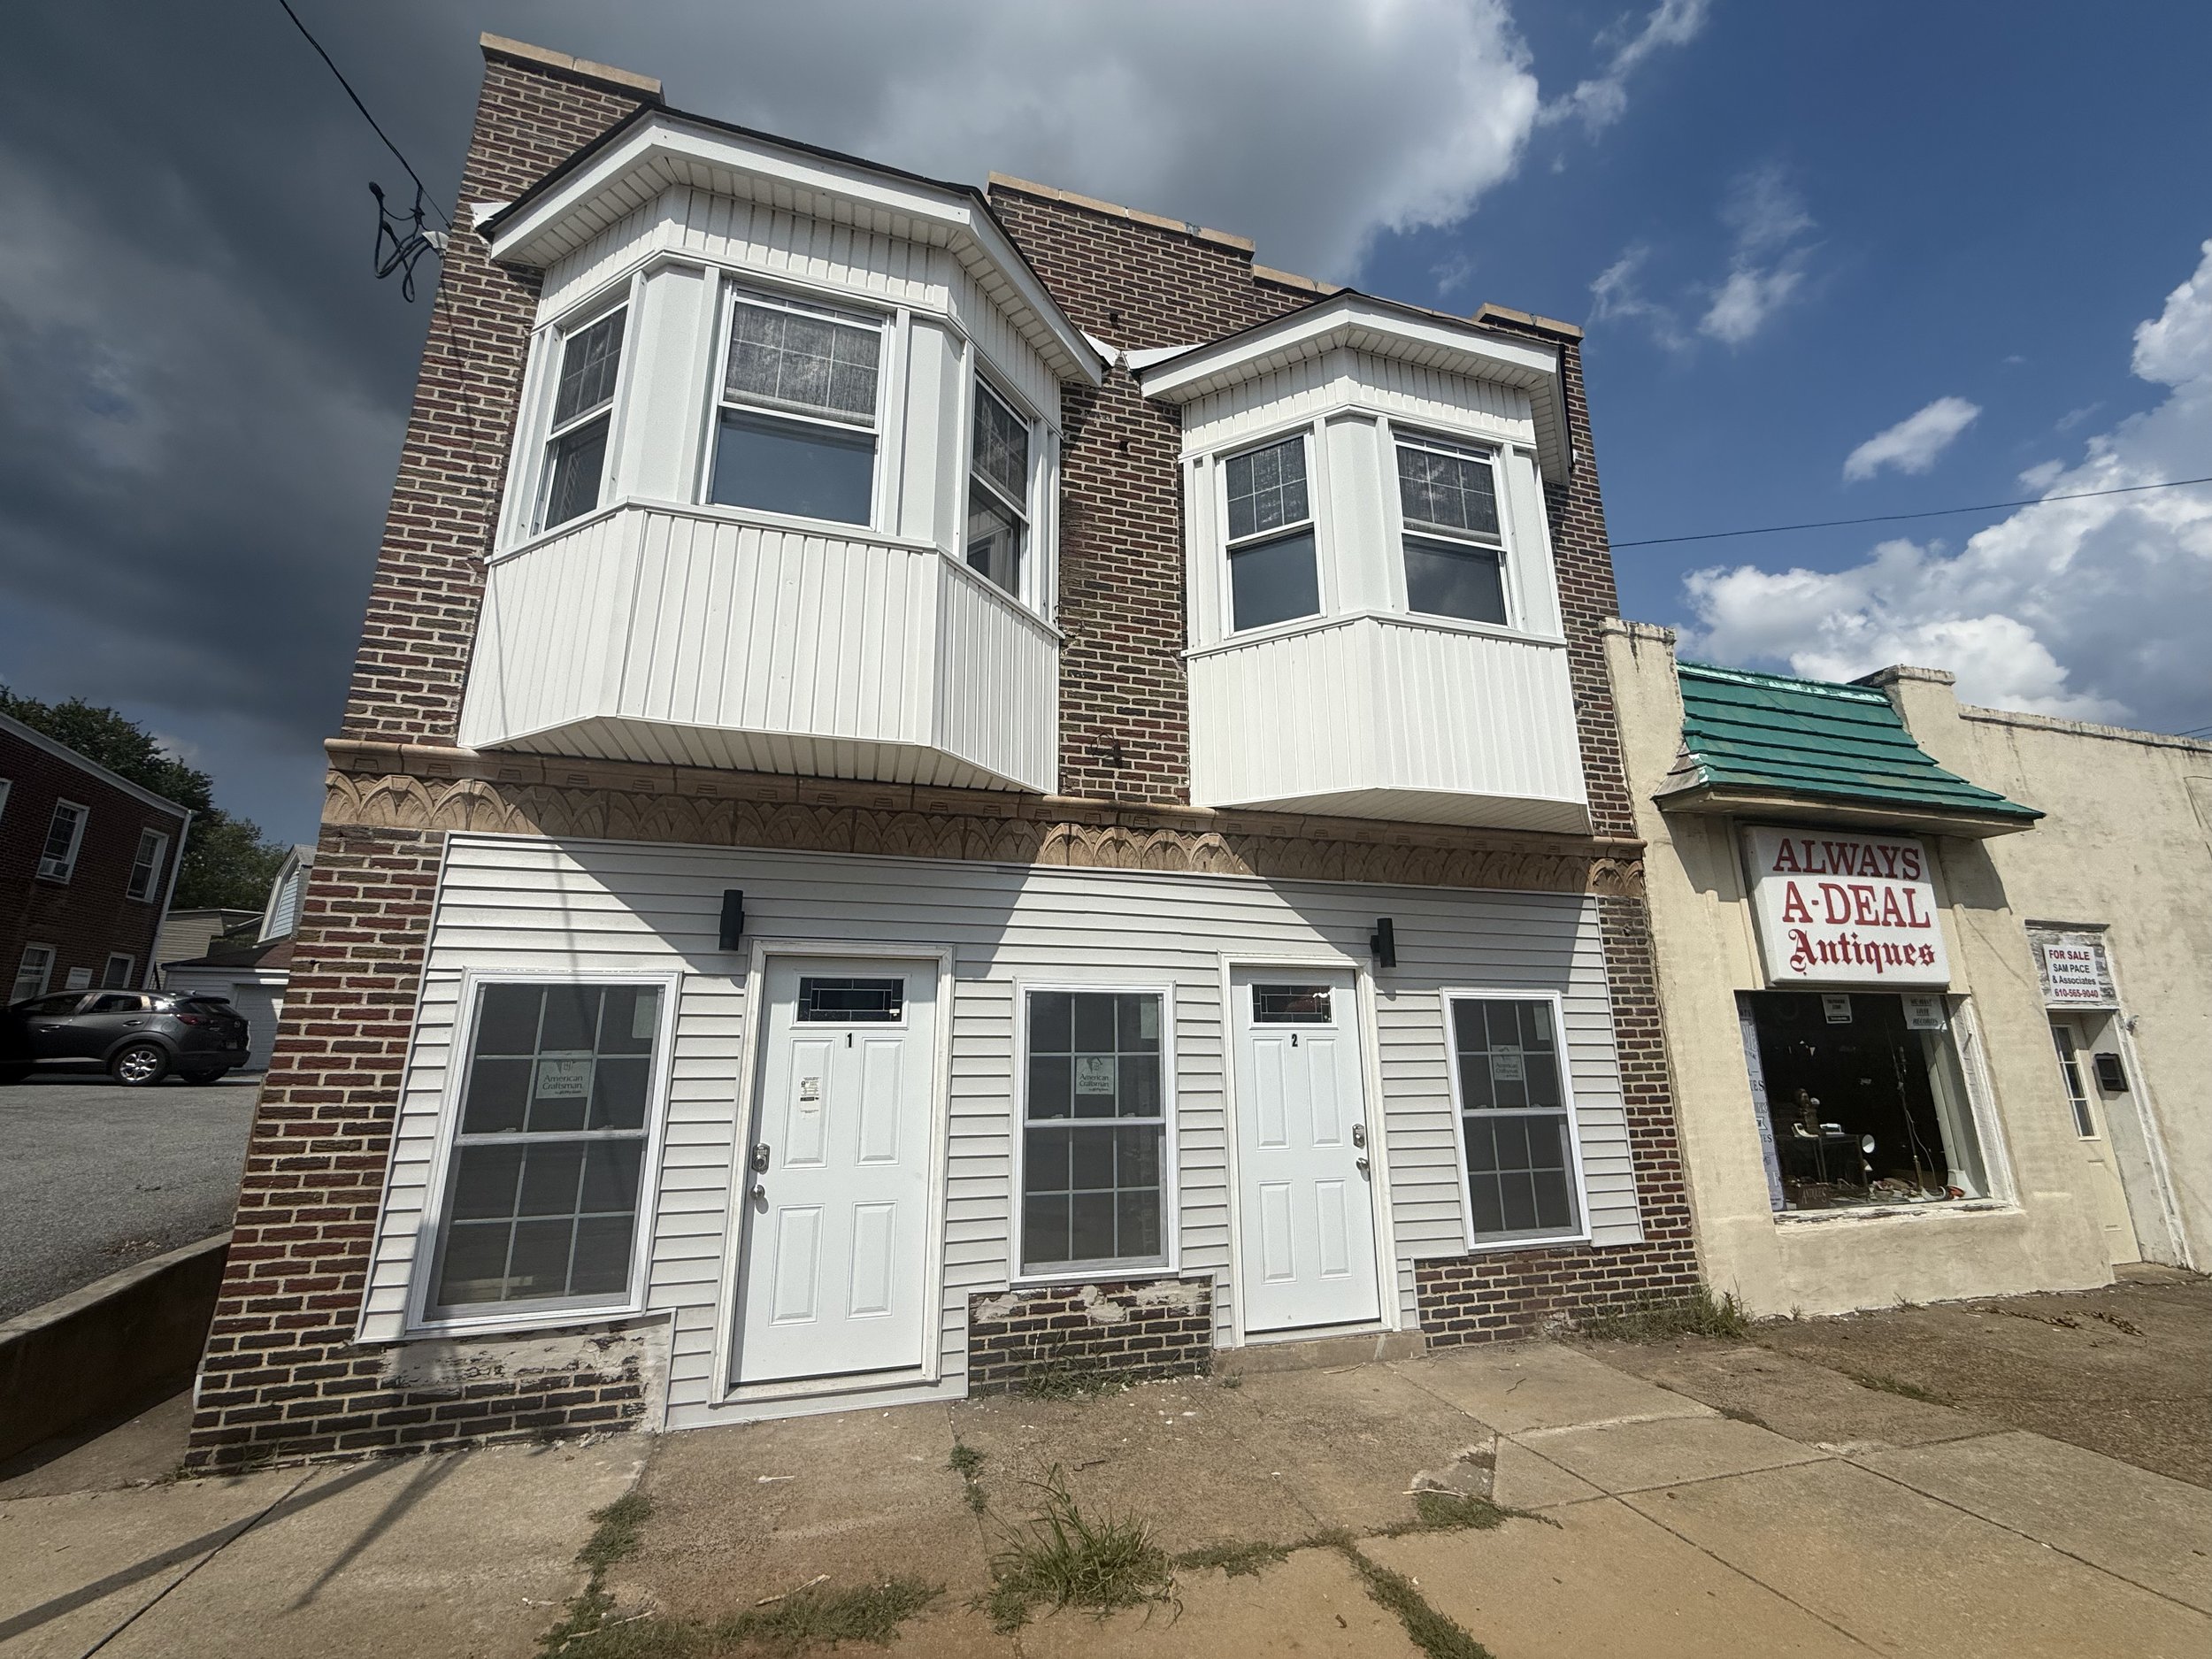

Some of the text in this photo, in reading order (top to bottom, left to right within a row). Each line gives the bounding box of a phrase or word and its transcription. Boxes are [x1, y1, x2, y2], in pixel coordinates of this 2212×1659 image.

[1772, 838, 1921, 880] ALWAYS
[1782, 880, 1931, 928] A-DEAL
[1788, 928, 1936, 976] Antiques
[2048, 949, 2090, 961] FOR SALE
[2053, 964, 2090, 973] SAM PACE
[2052, 975, 2096, 985] & Associates
[2054, 988, 2099, 998] 610-565-9040
[847, 1033, 852, 1048] 1
[1292, 1033, 1298, 1047] 2
